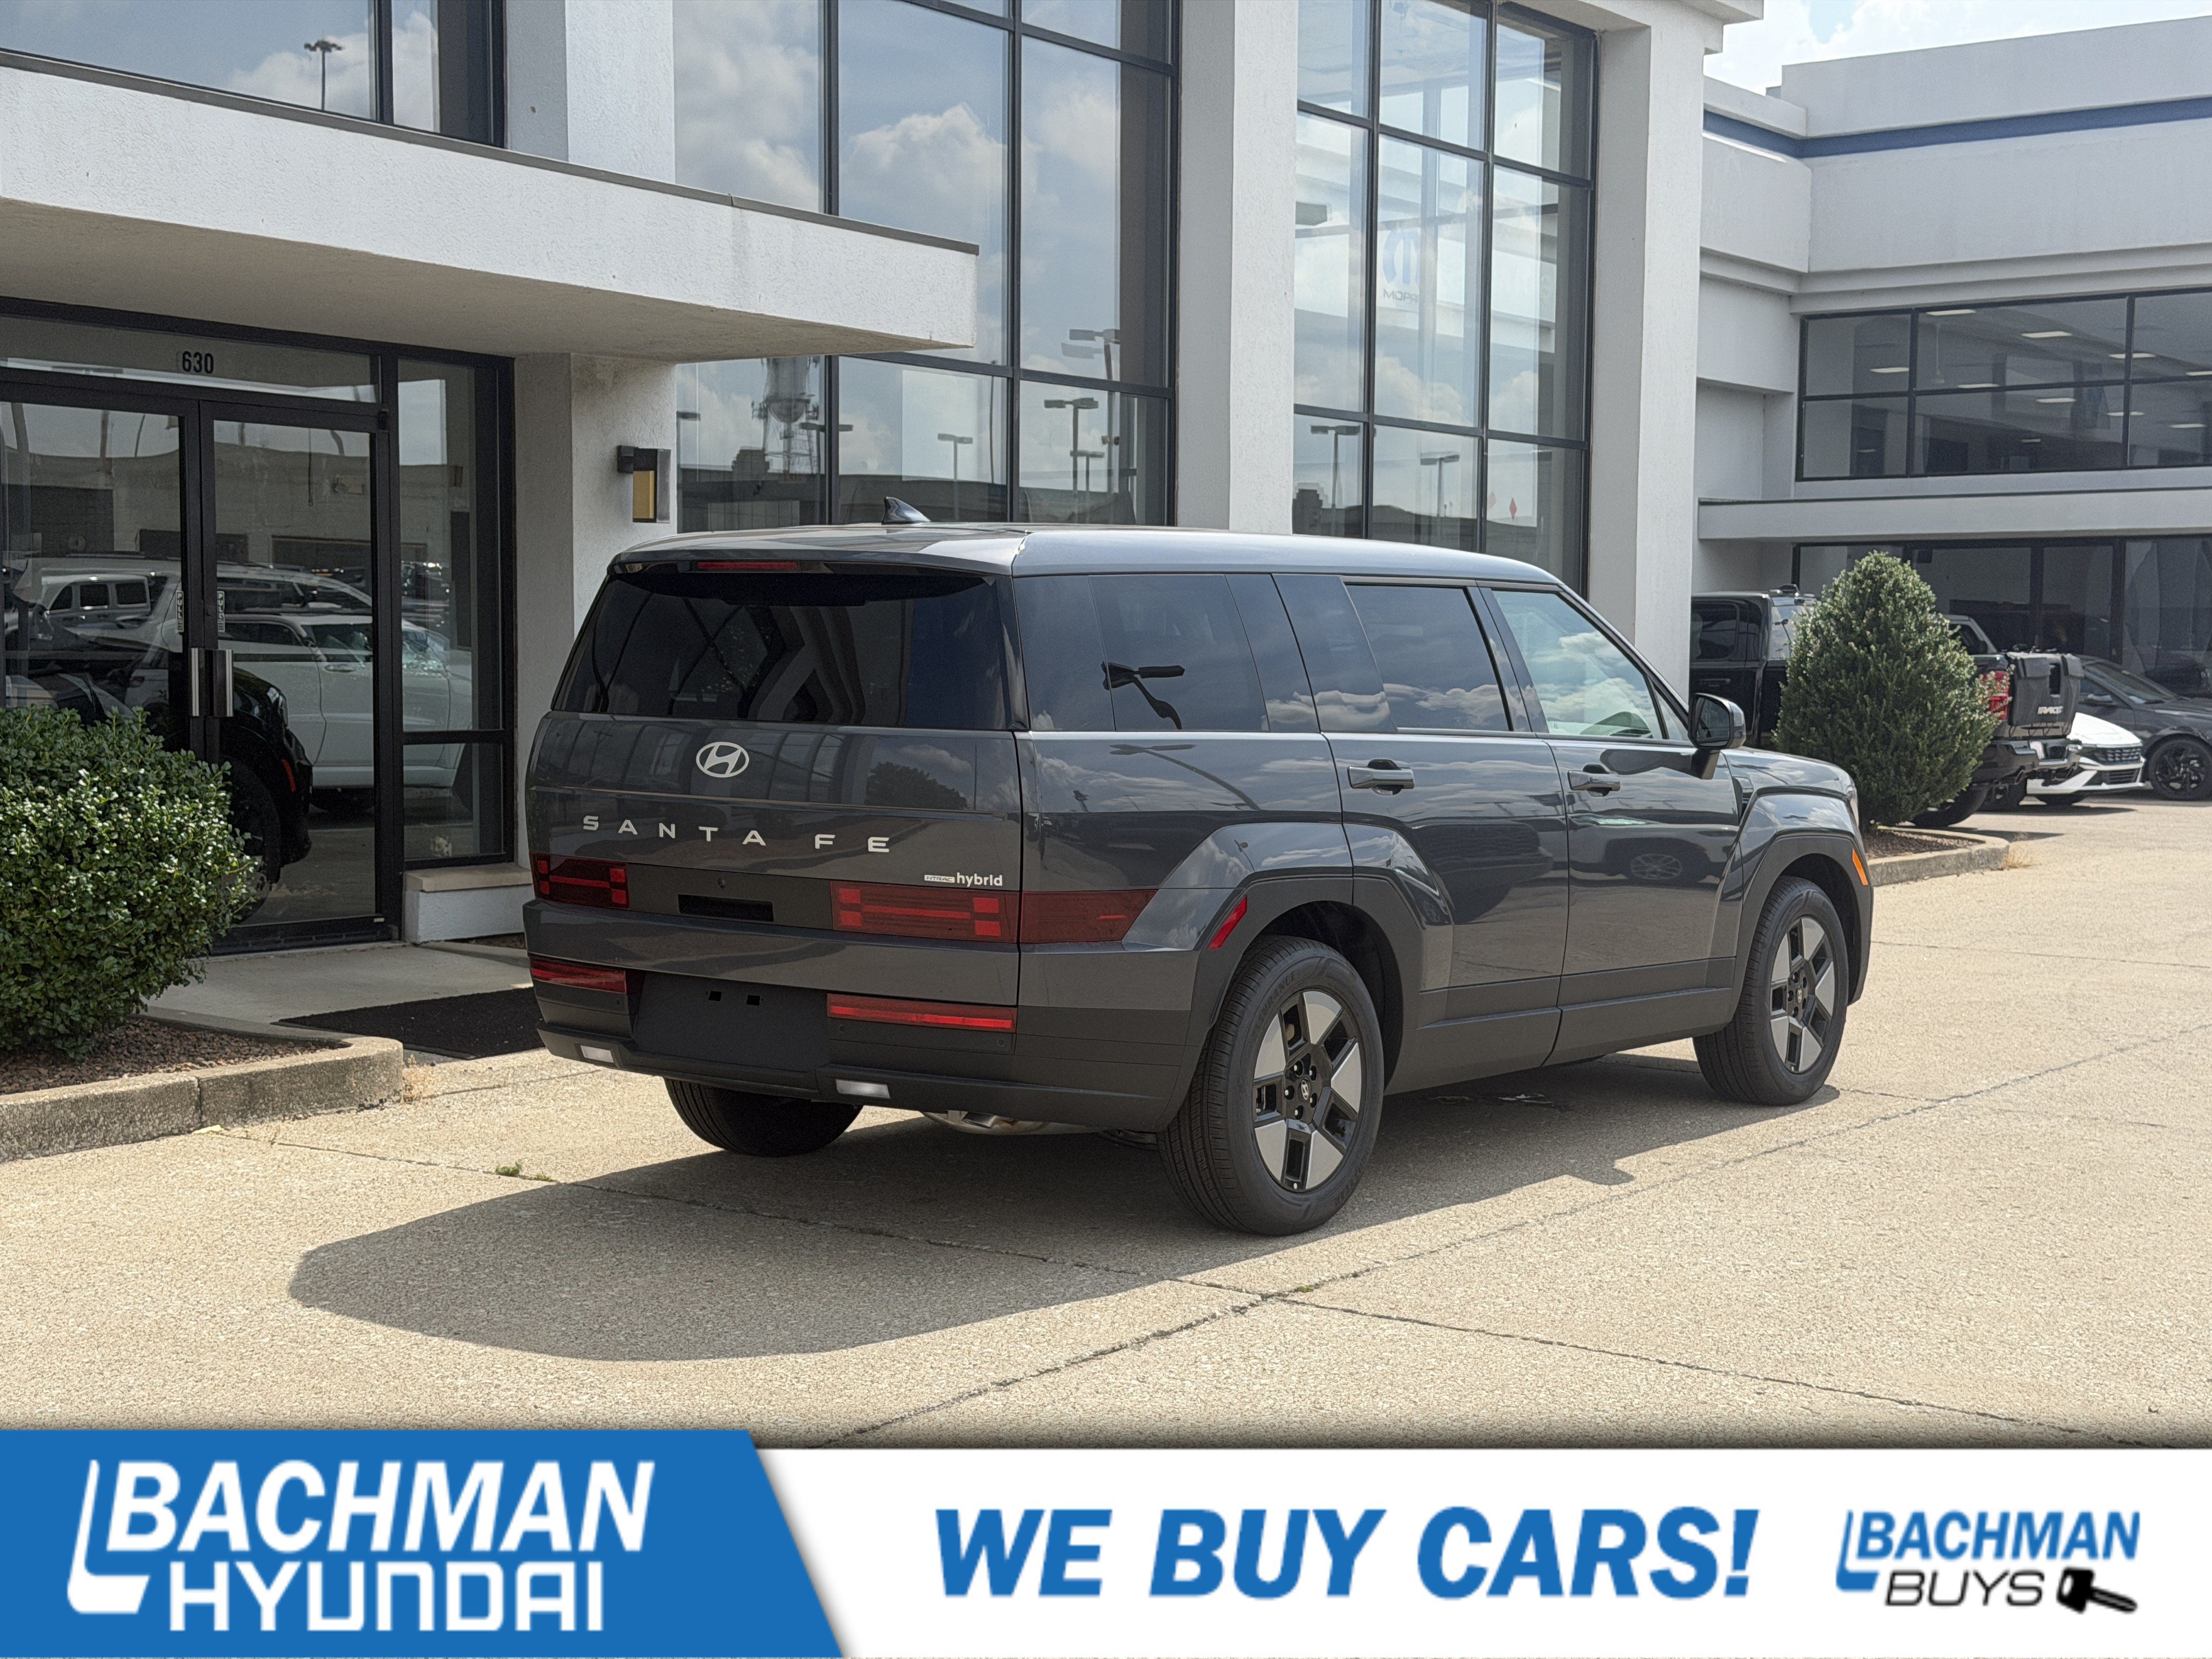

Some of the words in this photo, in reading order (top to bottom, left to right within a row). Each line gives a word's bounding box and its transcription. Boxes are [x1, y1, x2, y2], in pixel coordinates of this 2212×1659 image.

[1383, 289, 1420, 303] MOPA
[182, 351, 214, 374] 630
[583, 815, 766, 846] SANTA
[814, 834, 890, 853] FE
[957, 872, 1003, 888] hybrid
